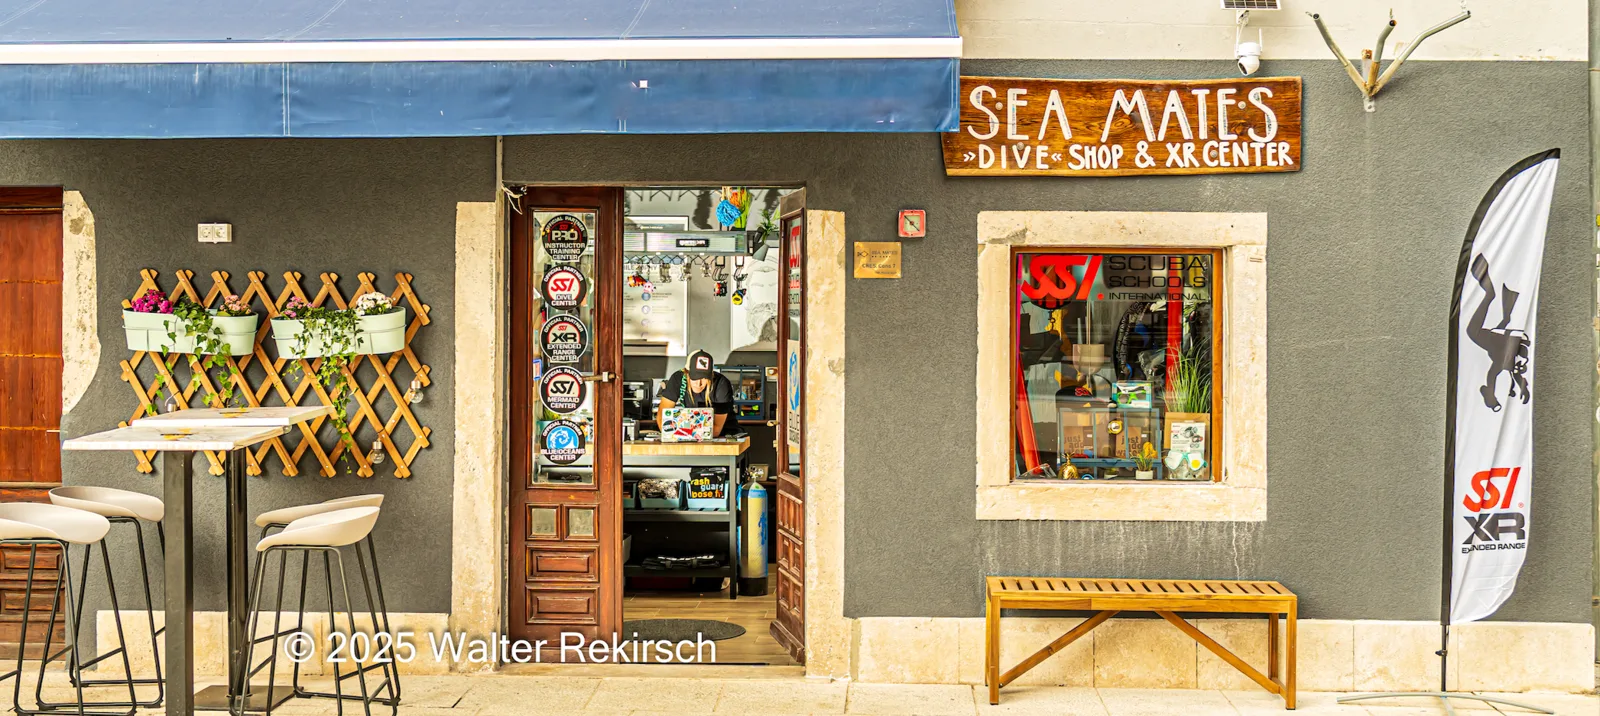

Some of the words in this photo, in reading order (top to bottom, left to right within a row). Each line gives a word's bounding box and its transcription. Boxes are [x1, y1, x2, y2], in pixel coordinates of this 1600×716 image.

[967, 85, 1072, 141] SEA
[1100, 87, 1278, 143] MATES
[1068, 144, 1124, 170] SHOP
[1135, 141, 1156, 168] &
[1165, 142, 1200, 168] XR
[1203, 141, 1294, 167] CENTER
[1109, 255, 1206, 271] SCUBA
[1021, 255, 1103, 300] SSI
[1109, 276, 1206, 288] SCHOOLS
[551, 278, 575, 292] SSI
[1109, 292, 1206, 300] INTERNATIONAL
[552, 333, 577, 342] XR
[550, 381, 575, 394] SSI
[691, 477, 710, 486] rash
[1463, 467, 1521, 512] SSI
[1462, 512, 1525, 544] XR
[1498, 542, 1525, 550] RANGE
